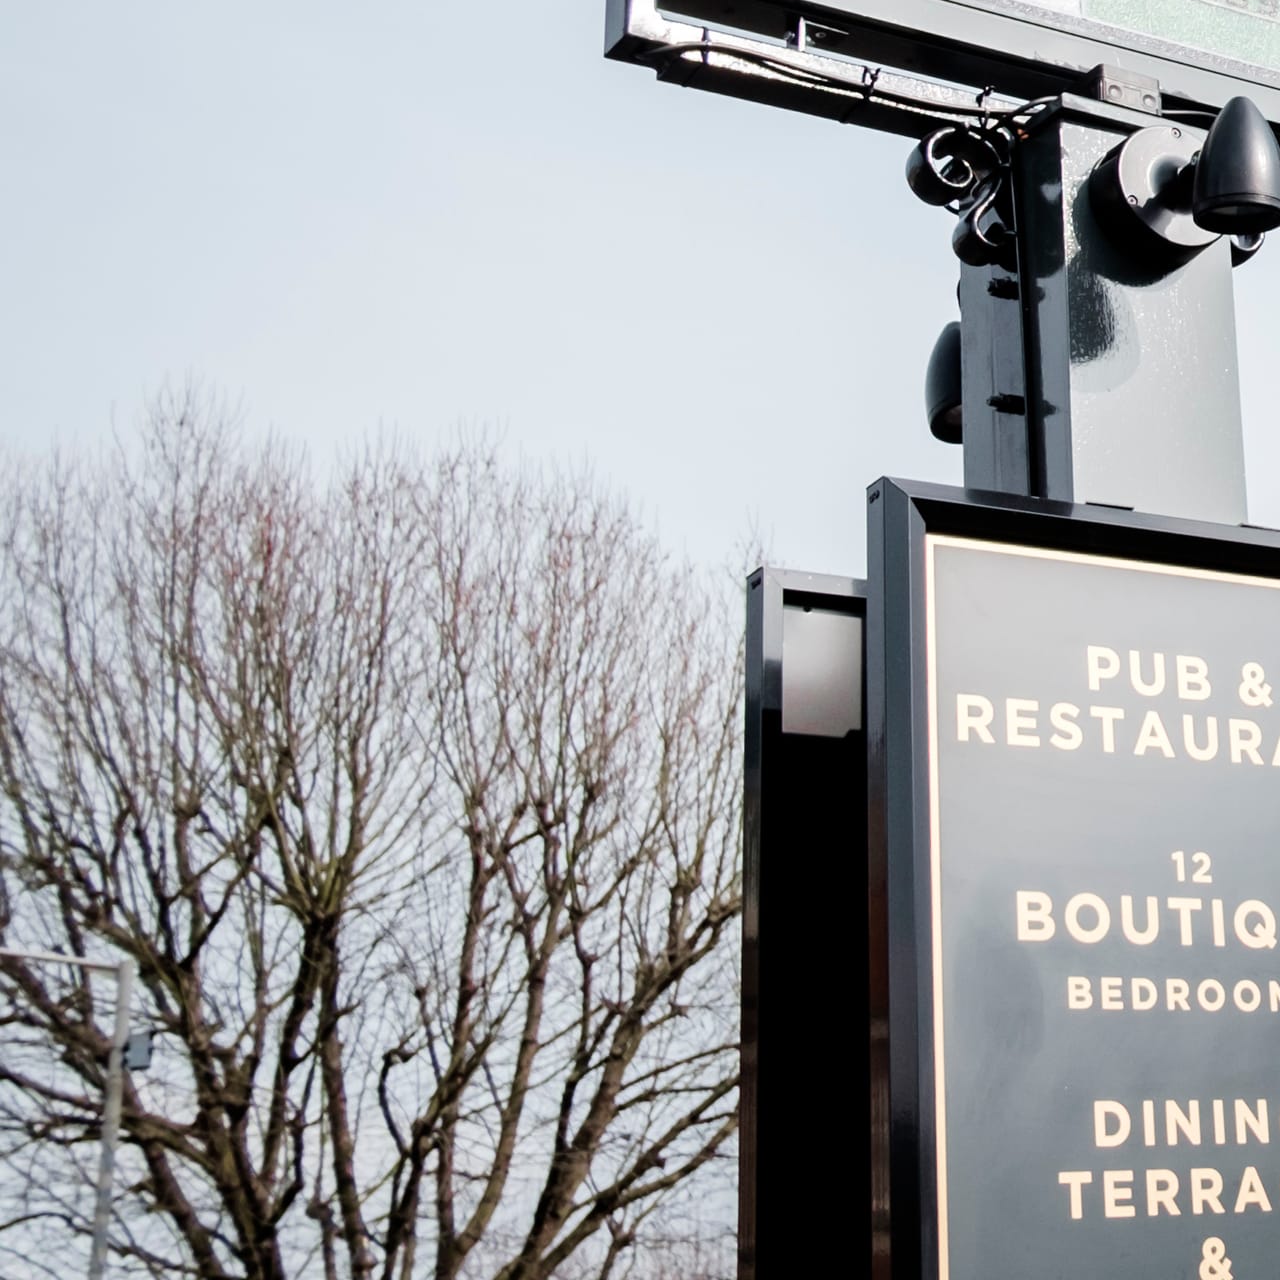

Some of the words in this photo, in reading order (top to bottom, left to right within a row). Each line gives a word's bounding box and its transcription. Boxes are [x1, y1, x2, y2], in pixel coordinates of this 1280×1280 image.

[1087, 645, 1212, 701] PUB
[1238, 661, 1274, 708] &
[1170, 850, 1213, 884] 12
[1199, 1236, 1234, 1280] &
